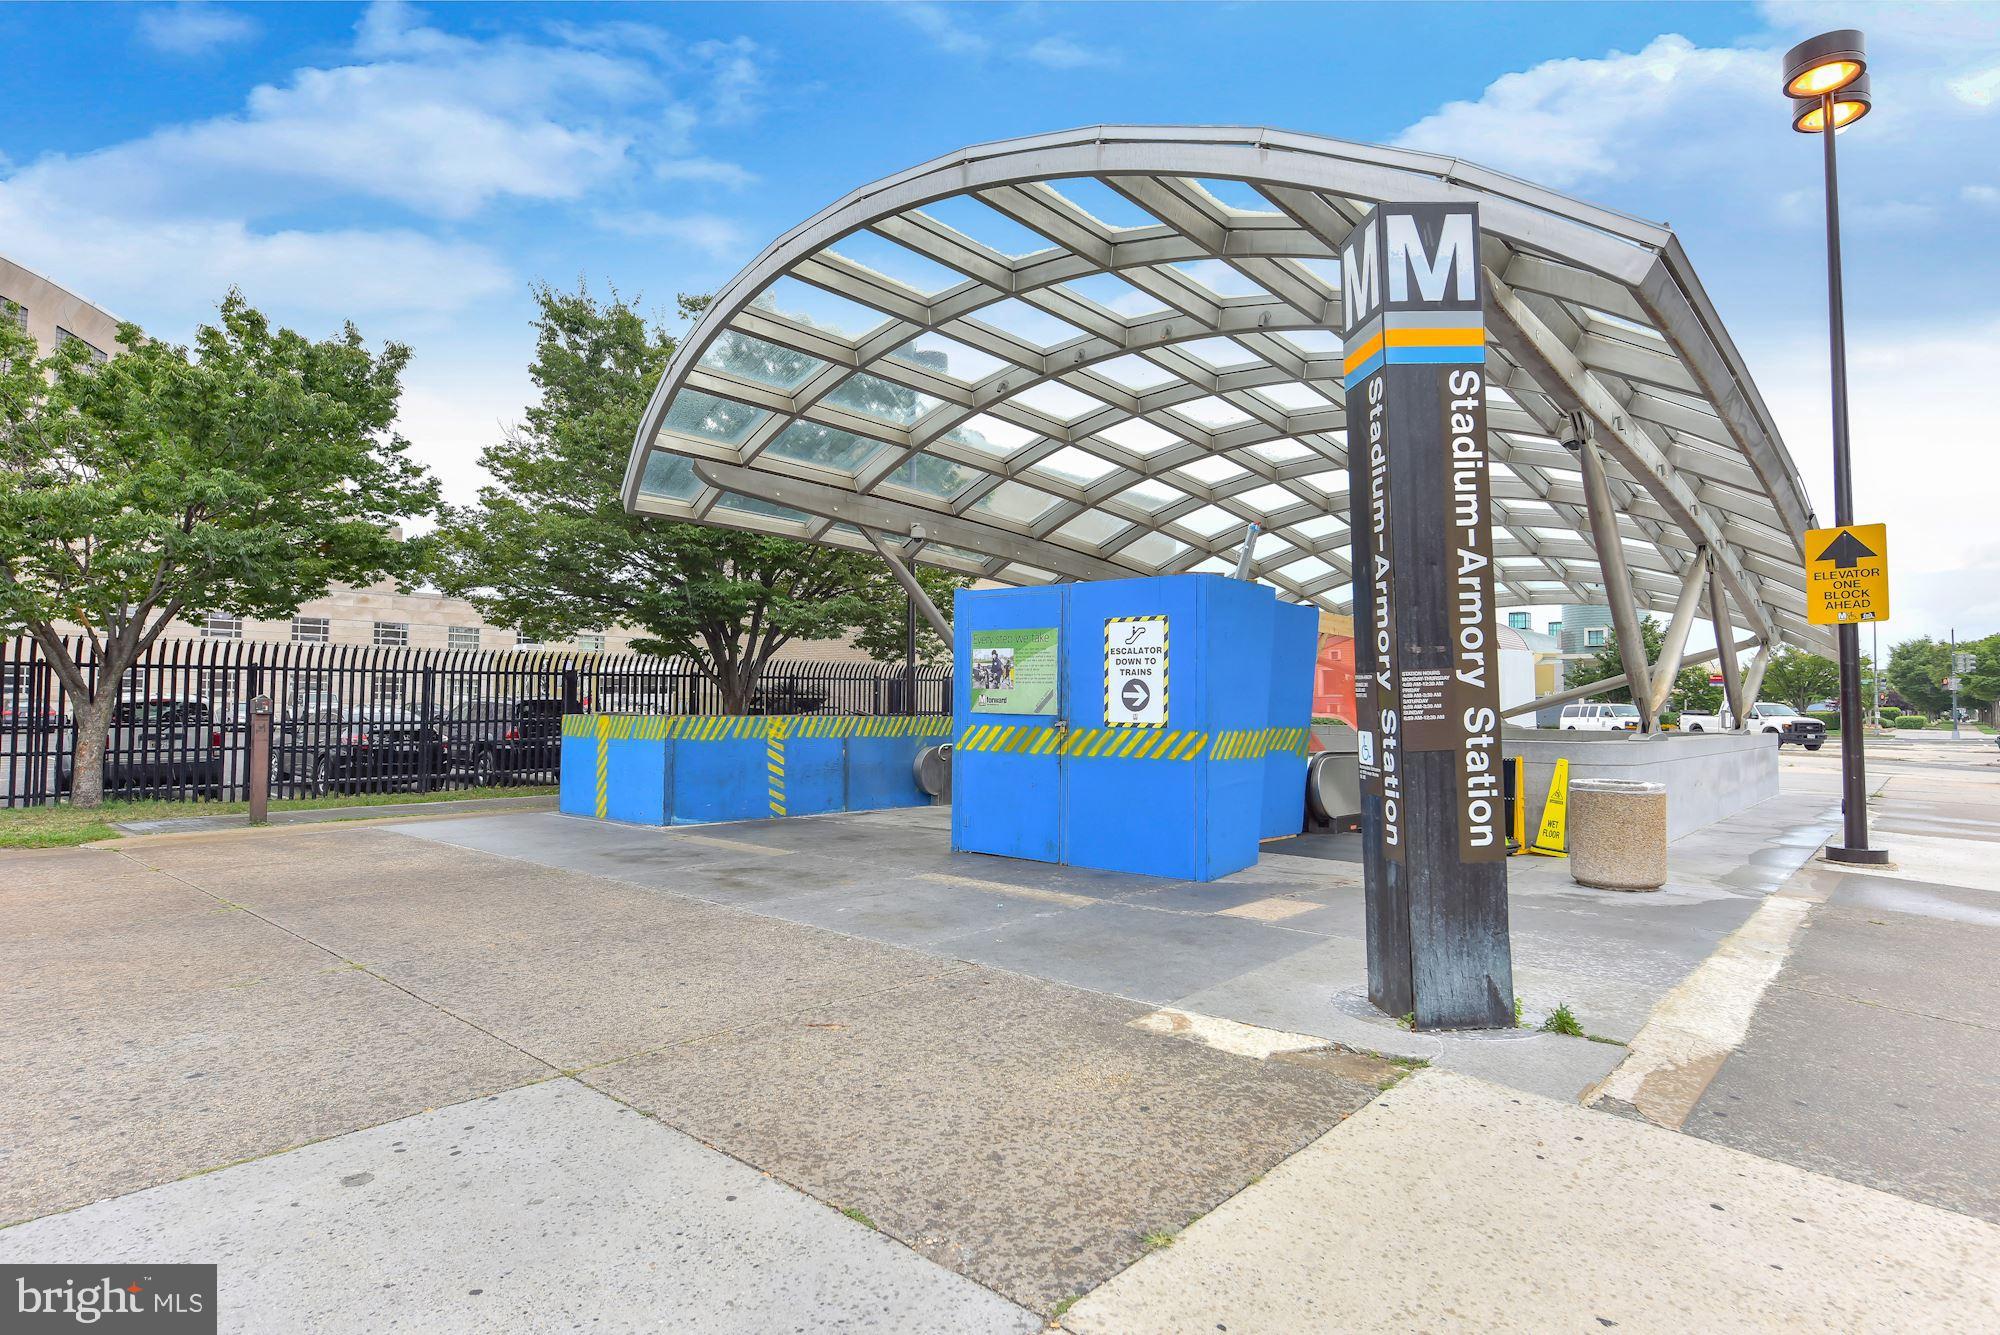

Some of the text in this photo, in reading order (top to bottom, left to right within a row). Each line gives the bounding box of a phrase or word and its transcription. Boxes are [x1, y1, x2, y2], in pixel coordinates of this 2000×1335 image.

[1386, 214, 1476, 301] M
[1344, 219, 1379, 332] M
[1814, 568, 1880, 580] ELEVATOR
[1833, 580, 1861, 589] ONE
[1824, 589, 1870, 600] BLOCK
[1825, 600, 1871, 610] AHEAD
[1031, 632, 1050, 643] take
[1110, 646, 1162, 655] ESCALATOR
[1115, 657, 1157, 666] DOWN TO
[1119, 668, 1152, 676] TRAINS
[1381, 708, 1400, 846] Station
[1463, 707, 1498, 847] Station
[1547, 820, 1559, 829] WET
[1542, 828, 1560, 839] FLOOR
